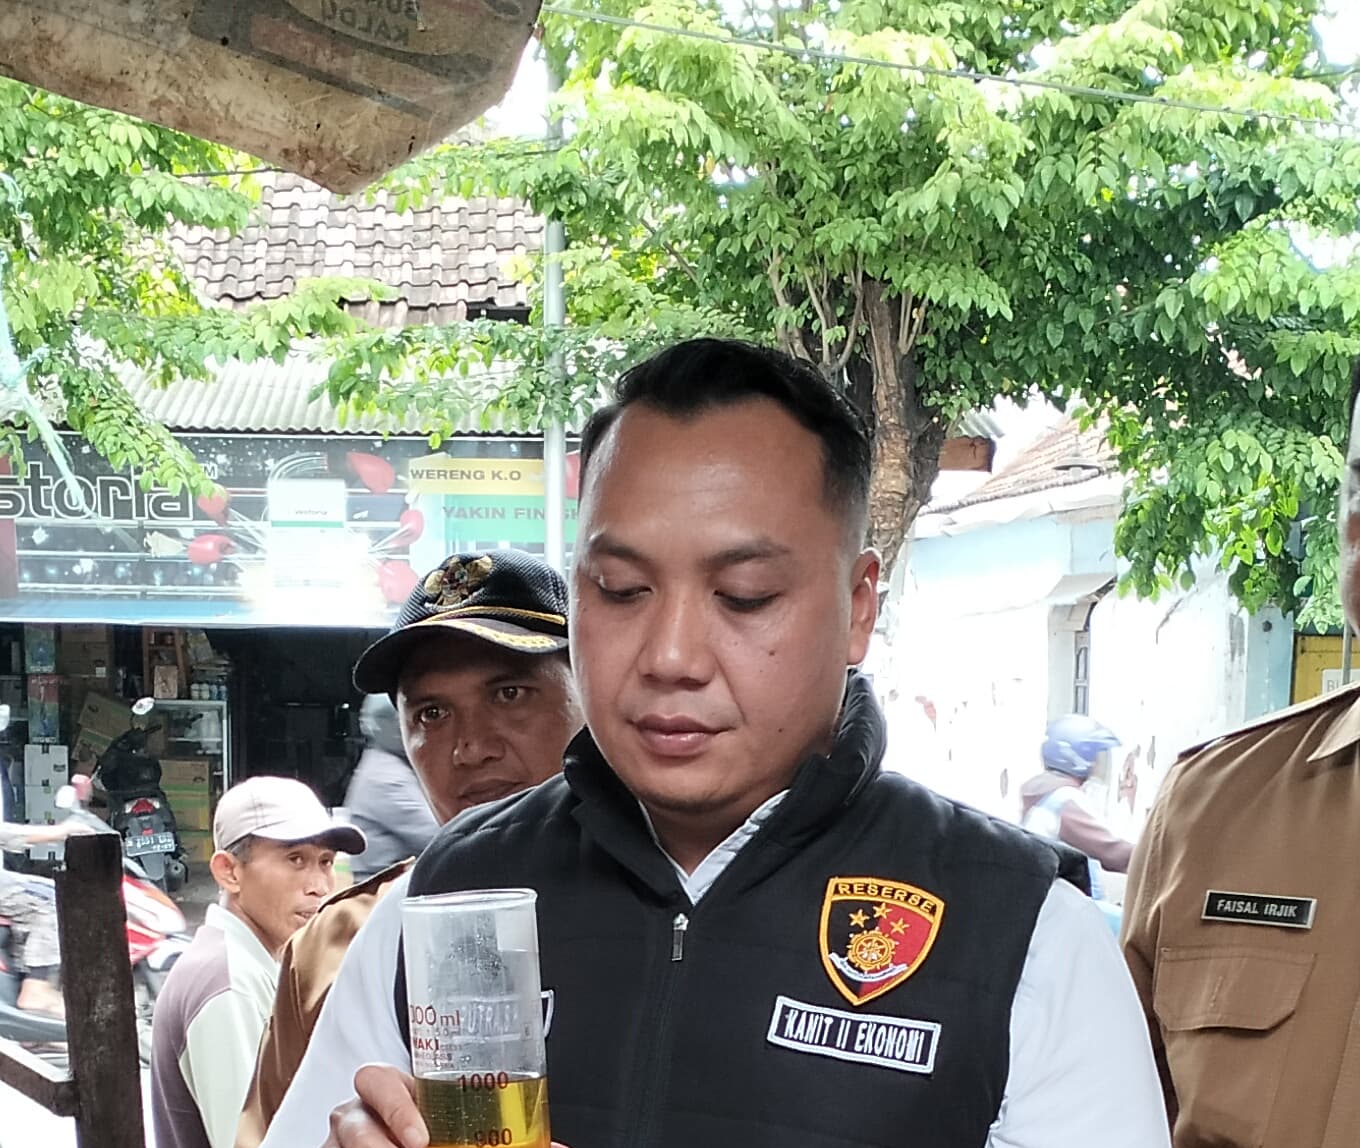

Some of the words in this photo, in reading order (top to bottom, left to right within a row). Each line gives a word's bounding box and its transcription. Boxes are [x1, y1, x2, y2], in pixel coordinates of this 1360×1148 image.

[410, 469, 485, 481] WERENG
[491, 470, 522, 481] K.O
[443, 506, 505, 520] YAKIN
[1216, 899, 1259, 916] FAISAL
[440, 1009, 461, 1027] ml
[783, 1009, 834, 1046] KANIT
[836, 1018, 851, 1049] II
[854, 1021, 926, 1063] EKONOMI
[459, 1071, 509, 1092] 1000
[475, 1128, 512, 1147] 900
